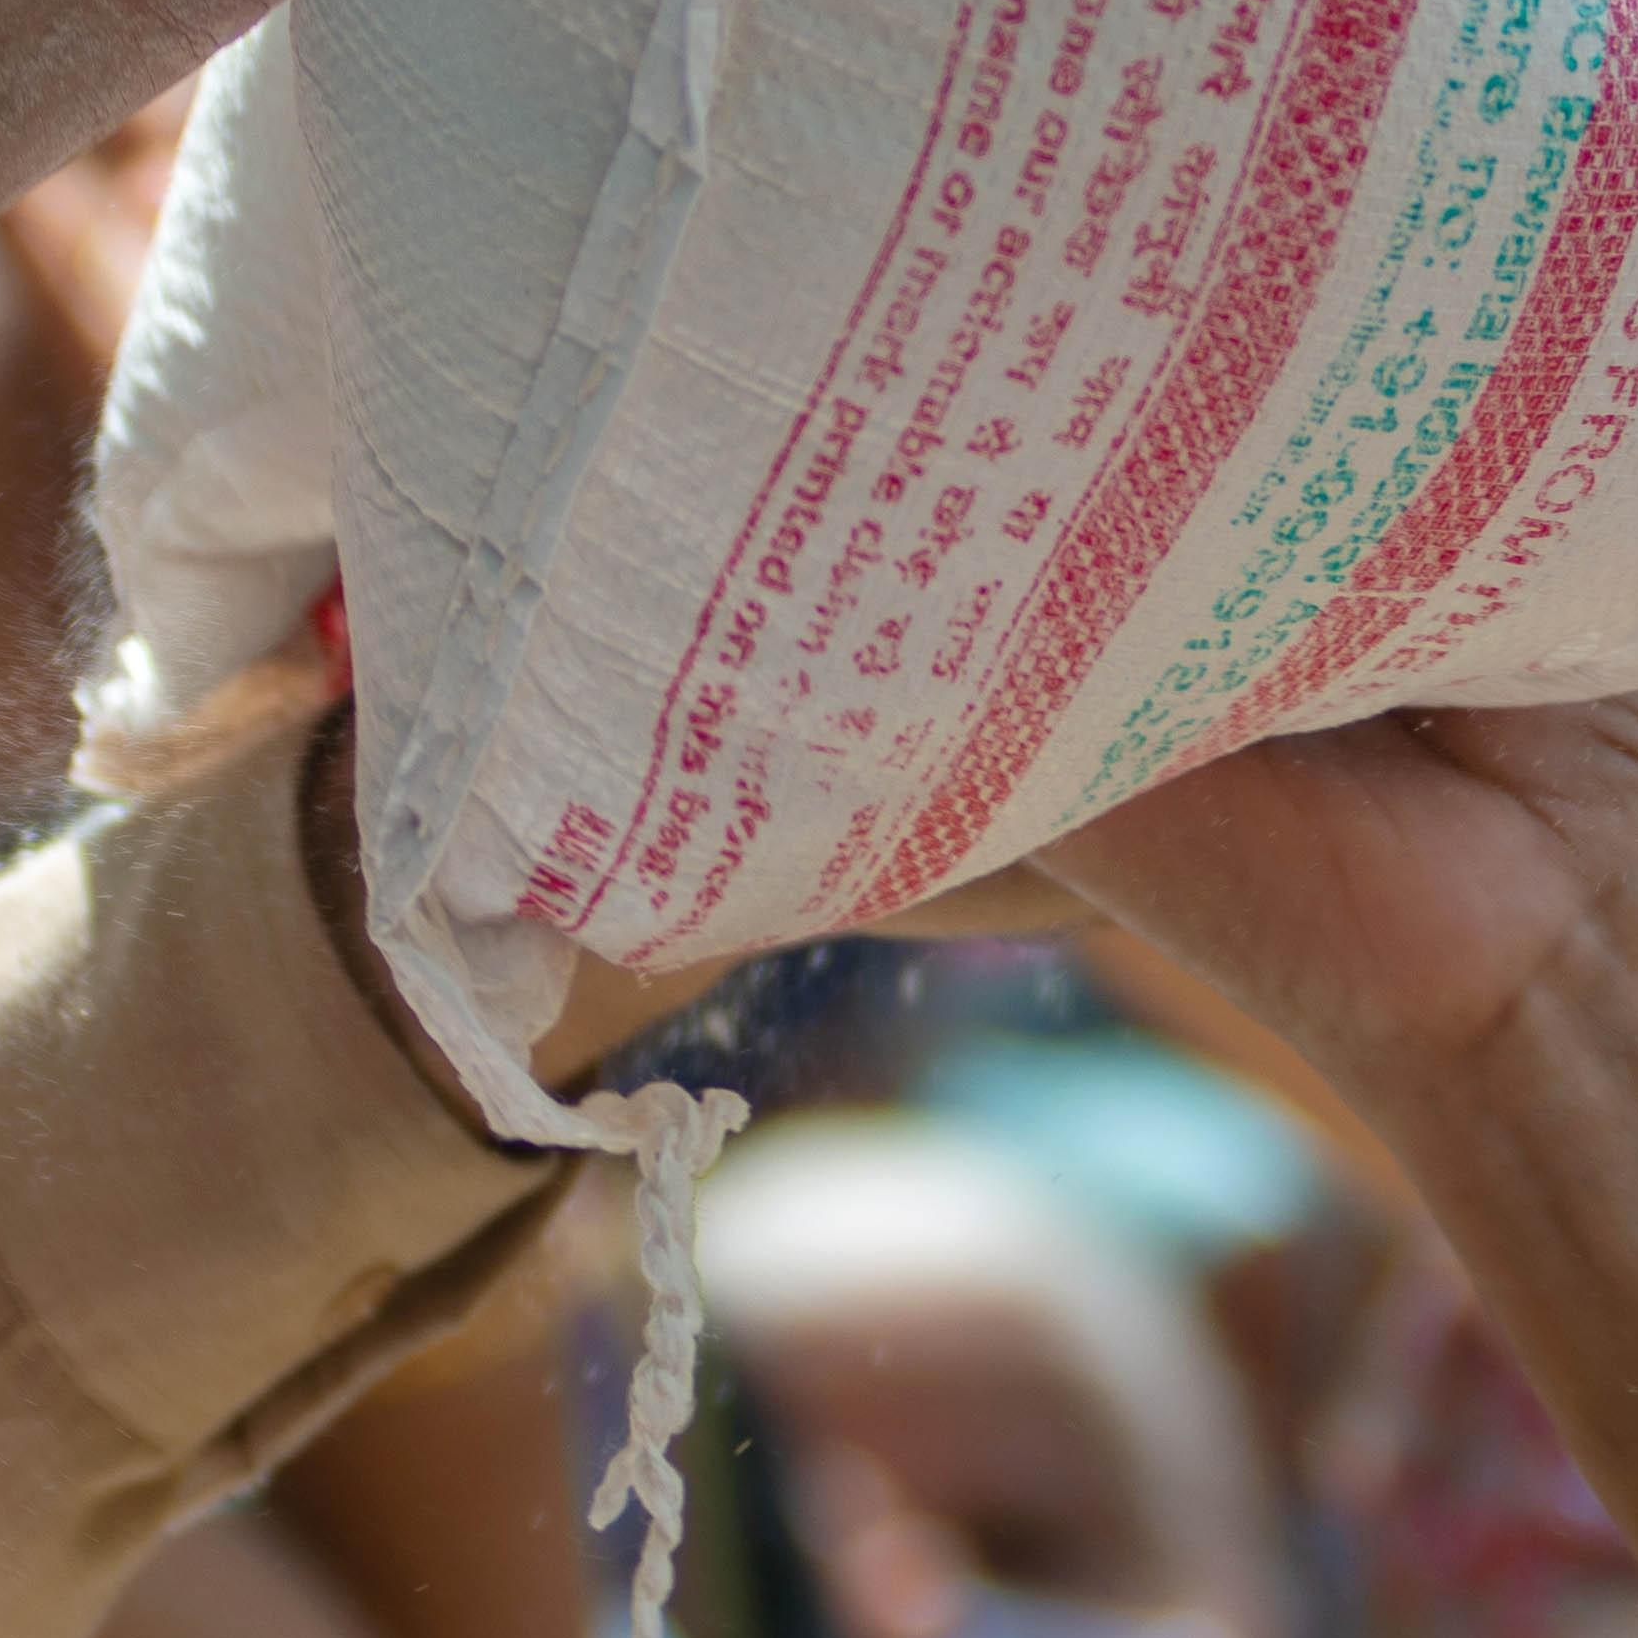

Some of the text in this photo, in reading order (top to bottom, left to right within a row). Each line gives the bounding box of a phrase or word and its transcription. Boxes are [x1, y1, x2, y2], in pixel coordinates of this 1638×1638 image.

[929, 169, 977, 238] or
[1013, 109, 1070, 216] our
[1423, 154, 1498, 269] no:
[716, 598, 768, 670] on
